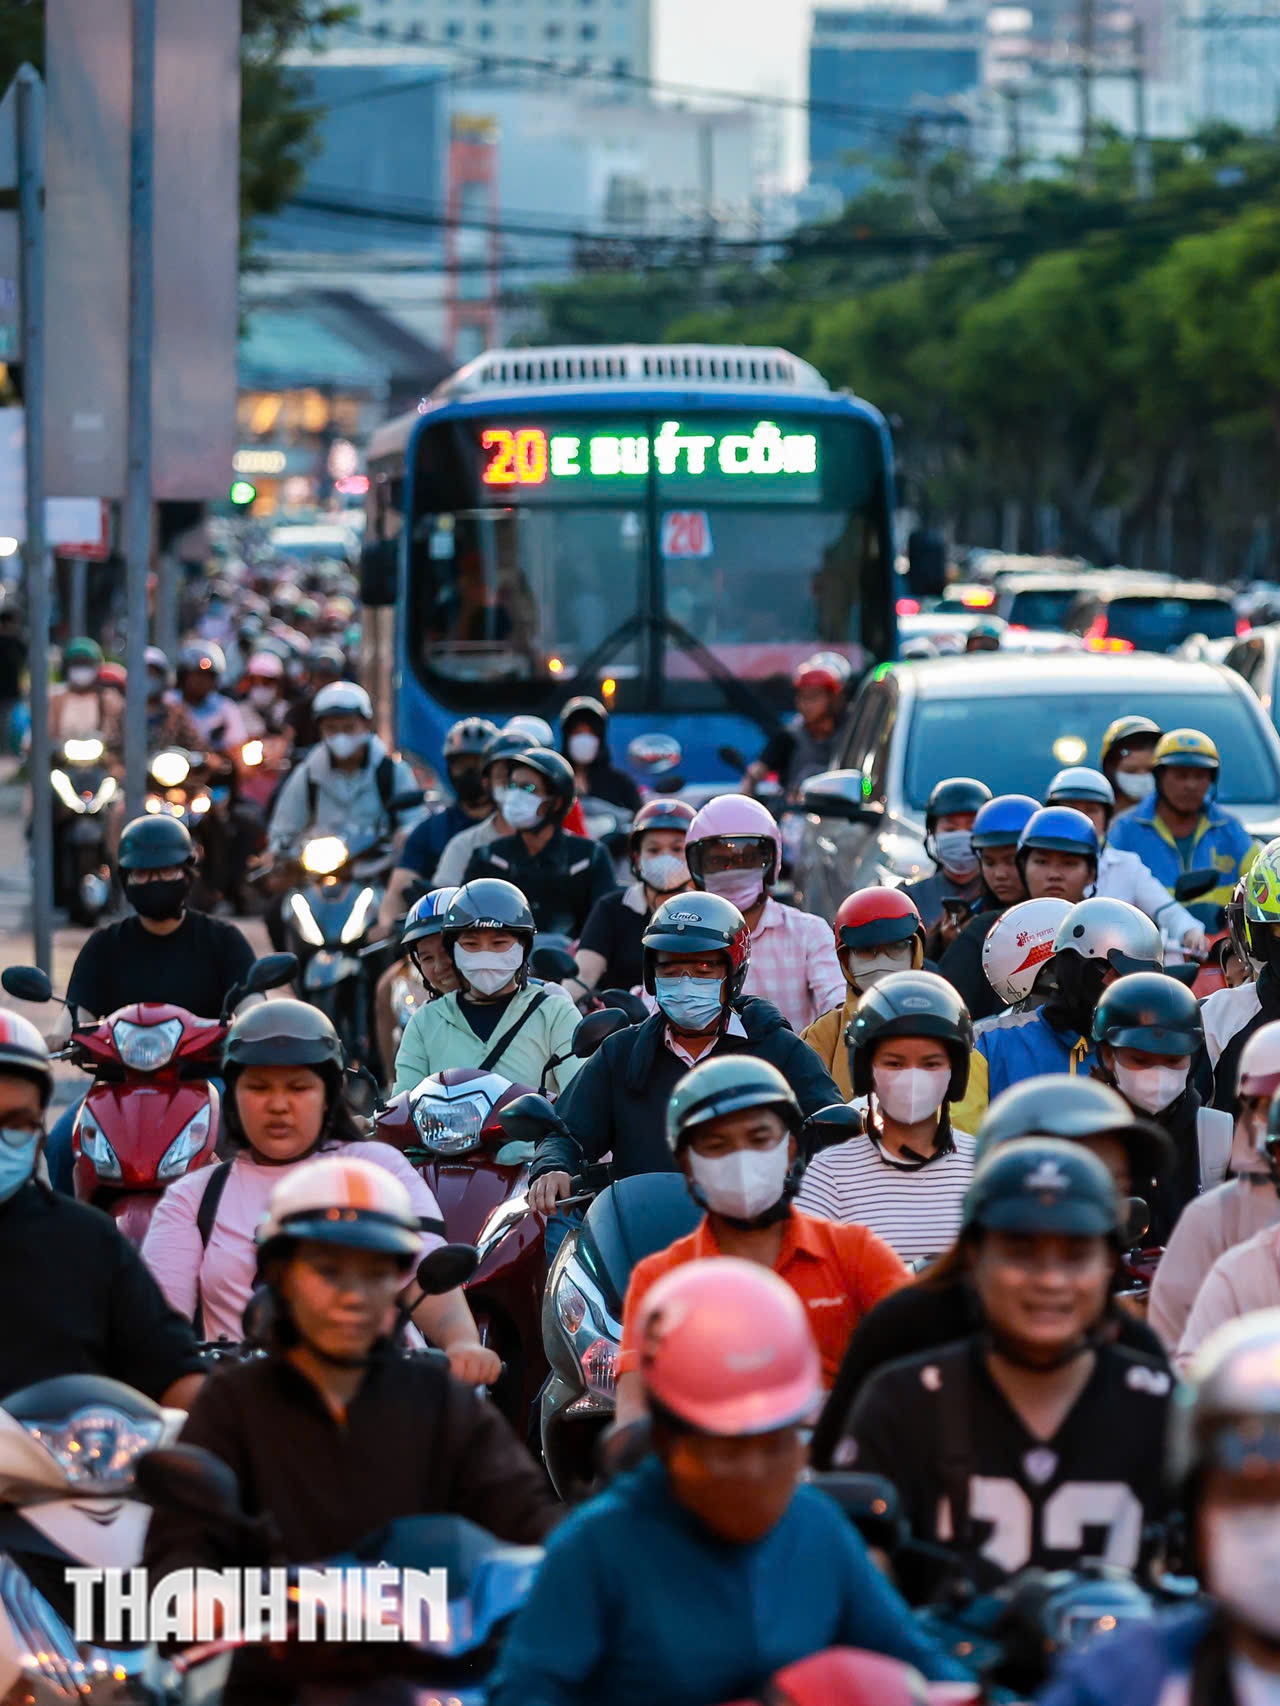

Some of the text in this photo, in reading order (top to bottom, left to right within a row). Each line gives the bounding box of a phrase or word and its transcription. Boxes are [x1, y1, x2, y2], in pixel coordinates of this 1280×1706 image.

[483, 430, 547, 484] 20
[669, 514, 703, 552] 20
[469, 919, 503, 928] Andes
